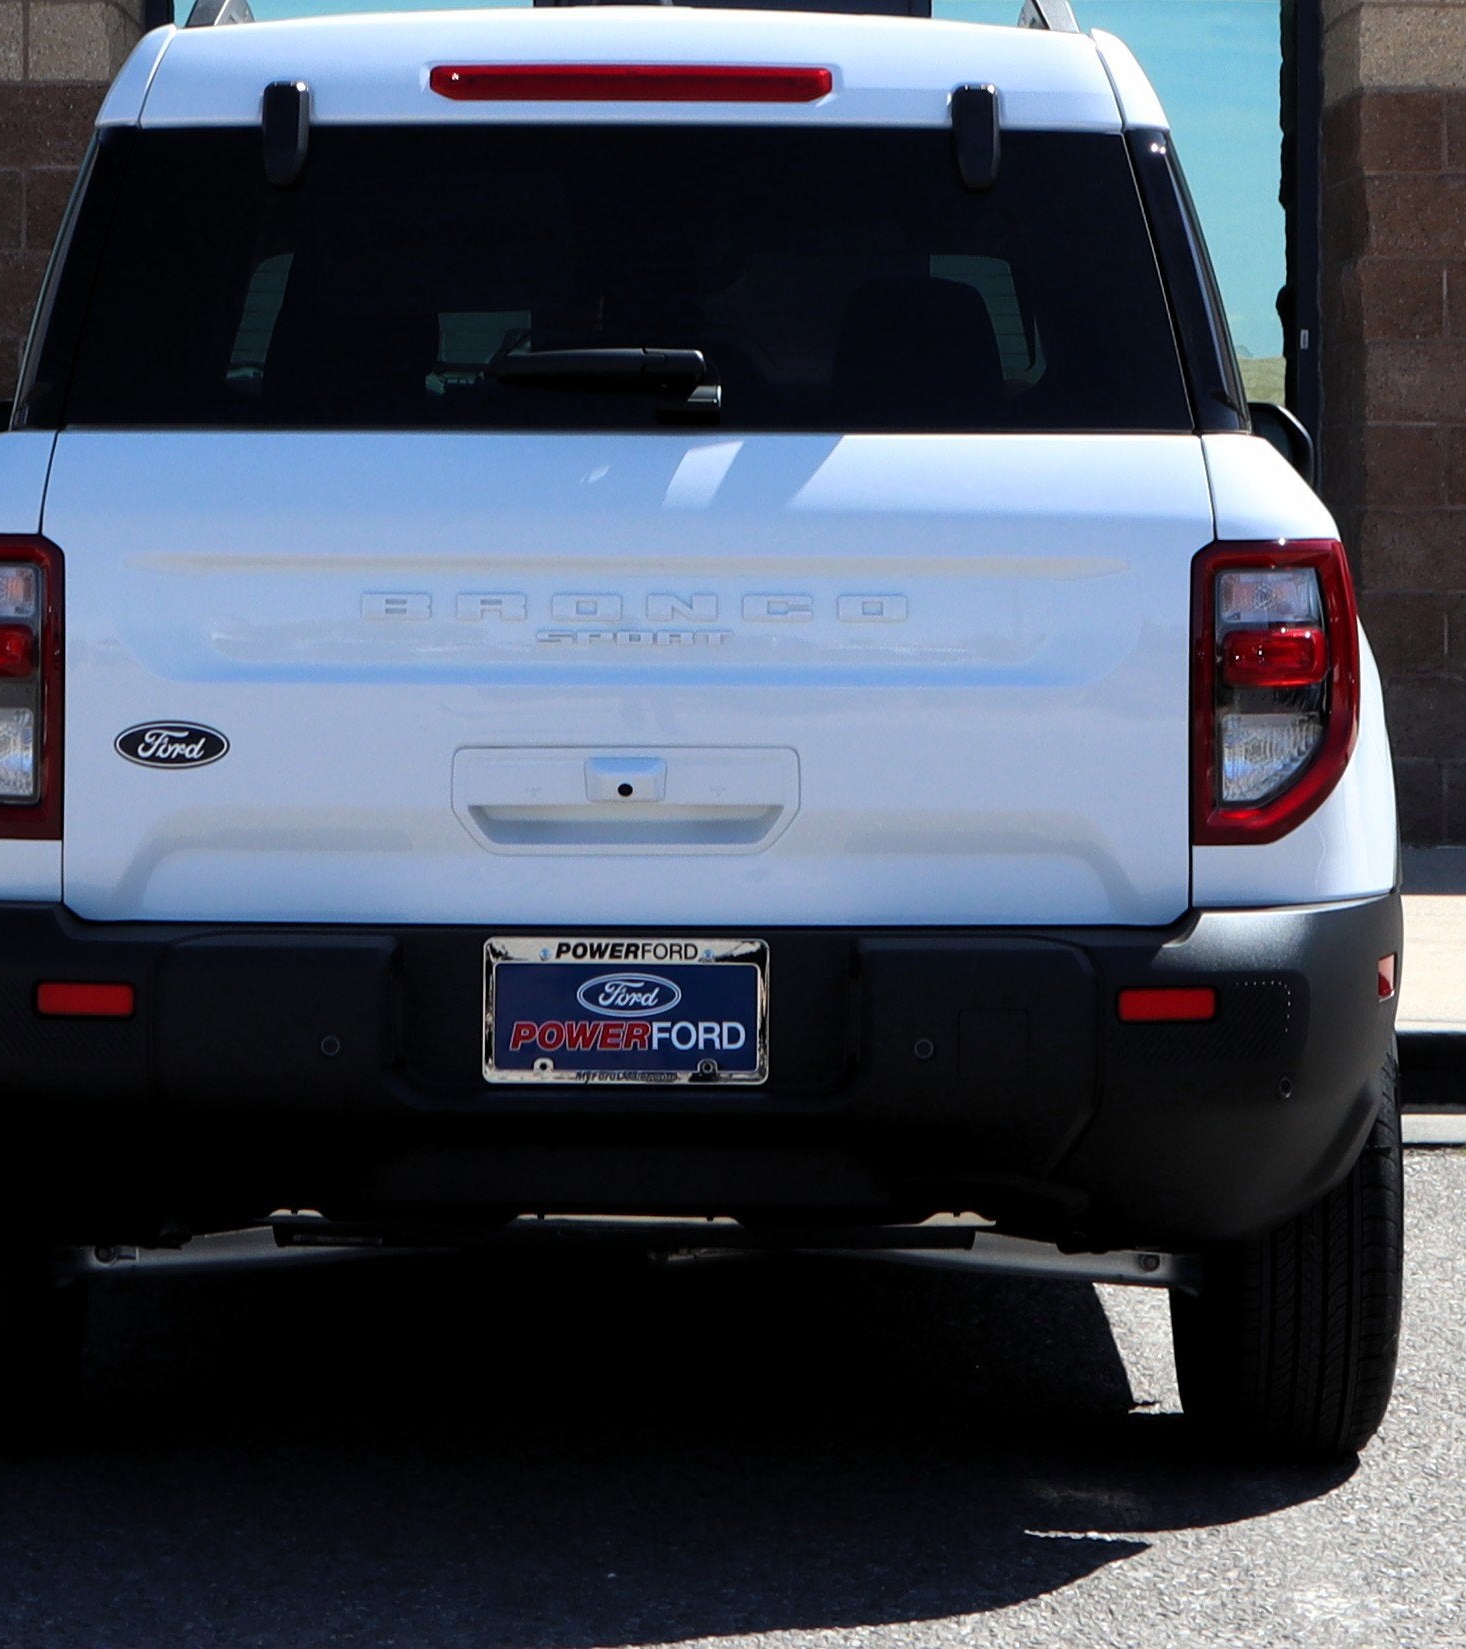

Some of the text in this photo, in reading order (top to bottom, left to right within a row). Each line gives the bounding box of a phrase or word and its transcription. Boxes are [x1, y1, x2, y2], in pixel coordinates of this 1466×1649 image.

[360, 591, 909, 622] BRONCO
[536, 629, 734, 646] SPORT
[137, 729, 206, 759] Ford
[598, 981, 659, 1007] Ford
